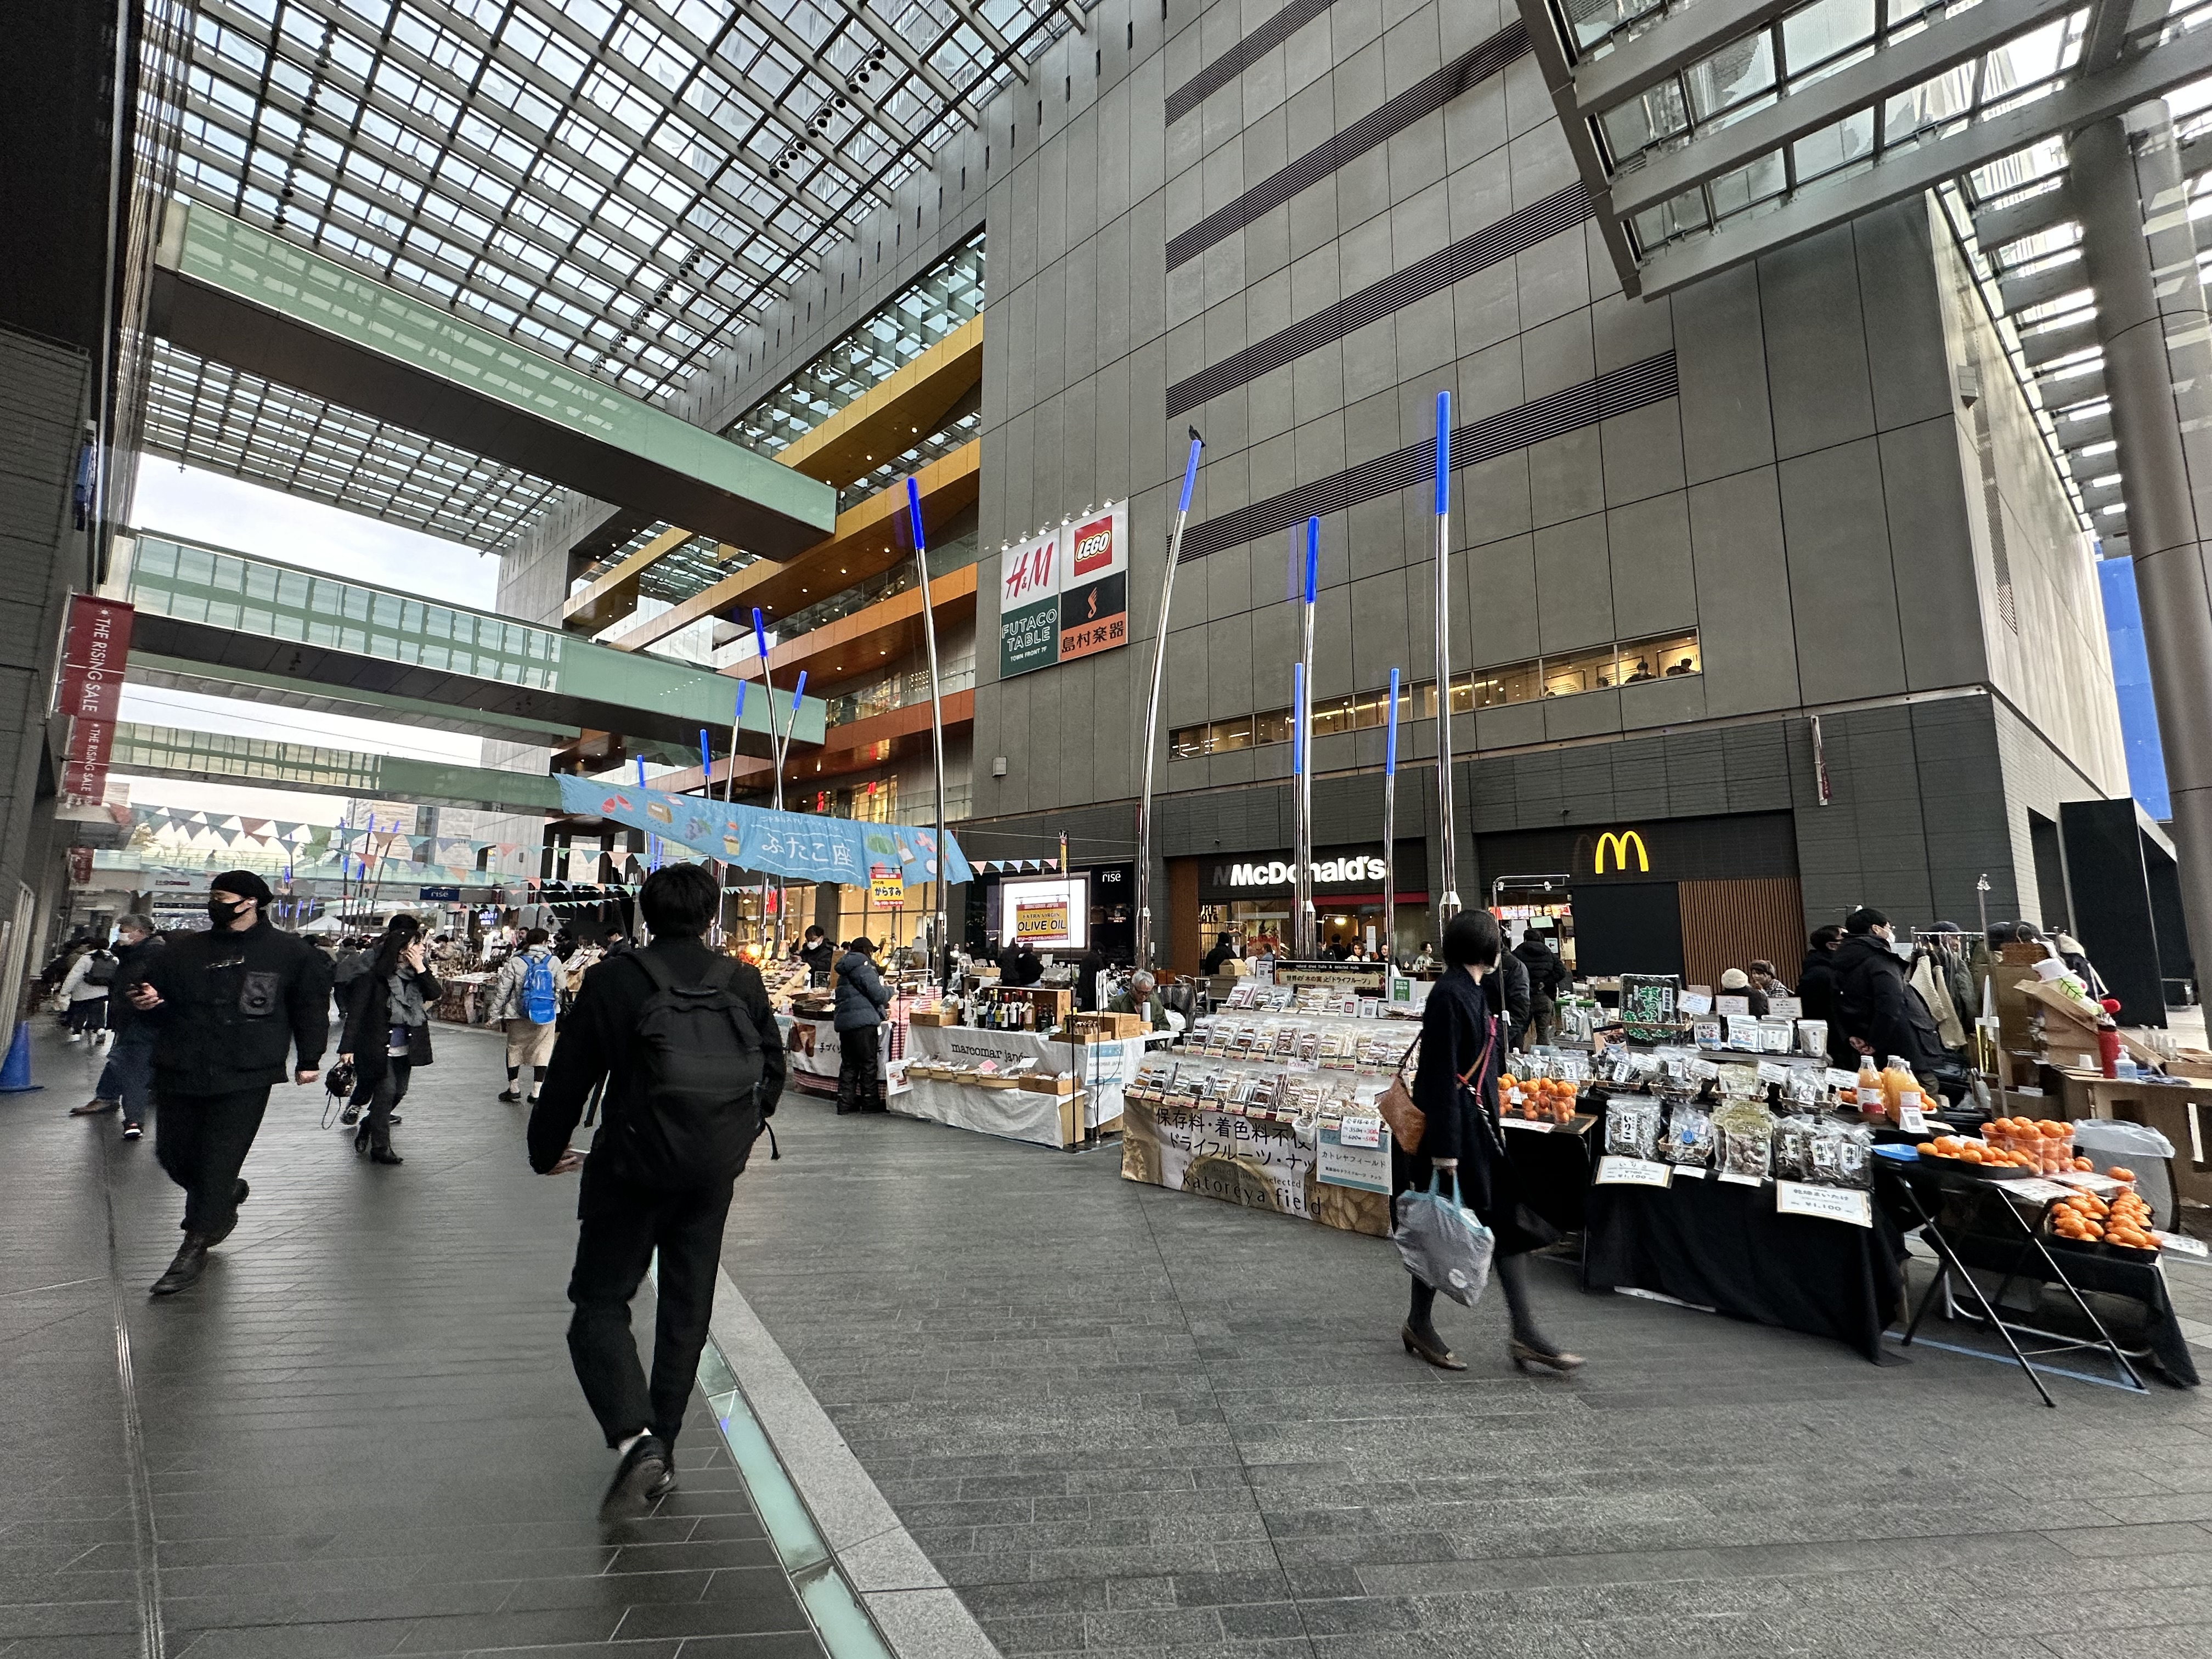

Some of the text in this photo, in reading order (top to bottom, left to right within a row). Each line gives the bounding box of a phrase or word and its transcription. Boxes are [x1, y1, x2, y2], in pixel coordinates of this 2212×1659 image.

[1076, 532, 1110, 560] LEGO
[1006, 541, 1053, 600] H&M
[94, 618, 111, 639] THE
[1002, 608, 1057, 639] FUTACO
[1007, 626, 1050, 651] TABLE
[1062, 620, 1124, 652] 島村楽器
[1011, 653, 1024, 662] TOWN
[1025, 649, 1040, 659] FRONT
[82, 683, 101, 713] SALE
[88, 729, 100, 743] THE
[81, 772, 94, 792] SALE
[761, 833, 854, 867] ふたこ座
[1102, 873, 1121, 882] rise
[874, 887, 901, 896] からすみ
[1018, 919, 1066, 932] OLIVE OIL
[951, 1043, 1002, 1058] marcomar
[1623, 1115, 1632, 1139] いりこ
[1322, 1151, 1386, 1168] カトレヤフィールド
[1183, 1170, 1321, 1216] katoreya field
